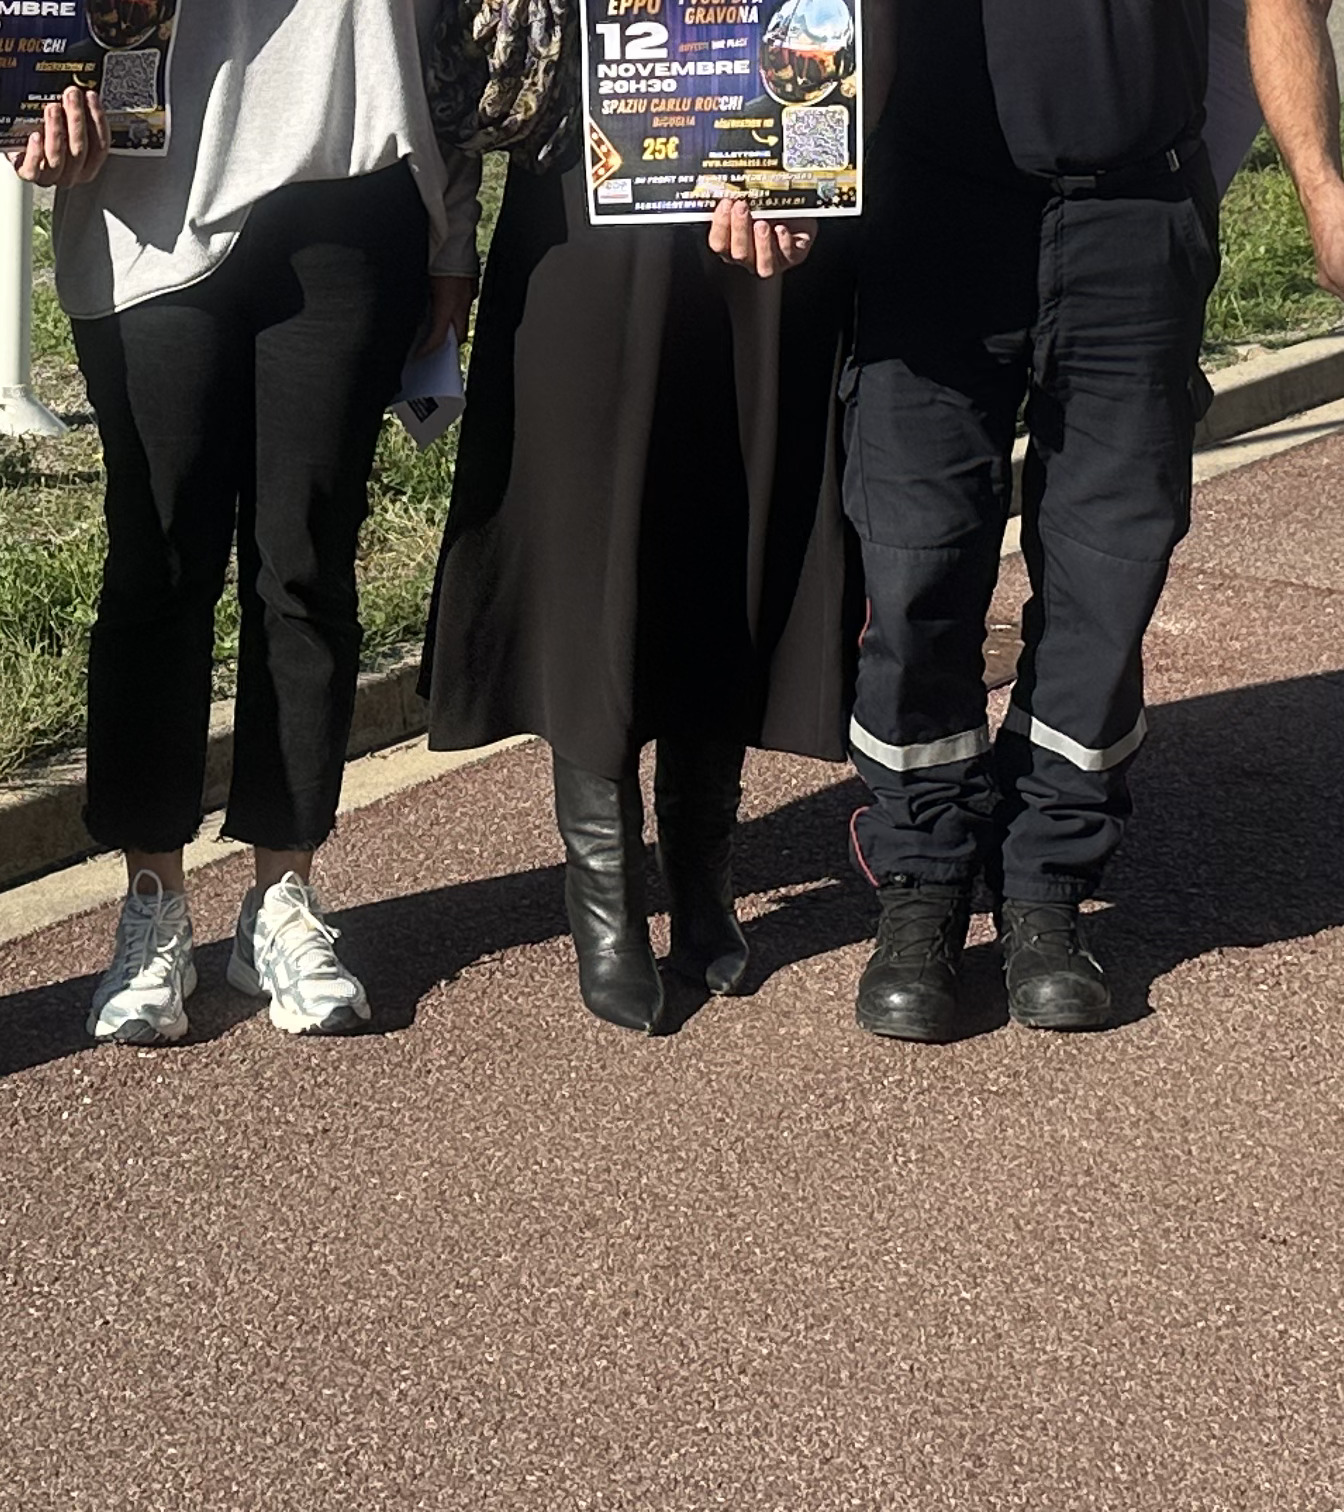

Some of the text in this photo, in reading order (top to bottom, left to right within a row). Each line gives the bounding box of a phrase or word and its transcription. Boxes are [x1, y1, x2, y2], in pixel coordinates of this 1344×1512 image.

[684, 6, 759, 25] GRAVONA
[17, 38, 68, 53] ROCCHI
[595, 21, 669, 60] 12
[597, 60, 751, 78] NOVEMBRE
[598, 78, 677, 94] 20H30
[601, 95, 743, 115] SPAZIU CARLU ROCCHI
[641, 135, 680, 161] 25€
